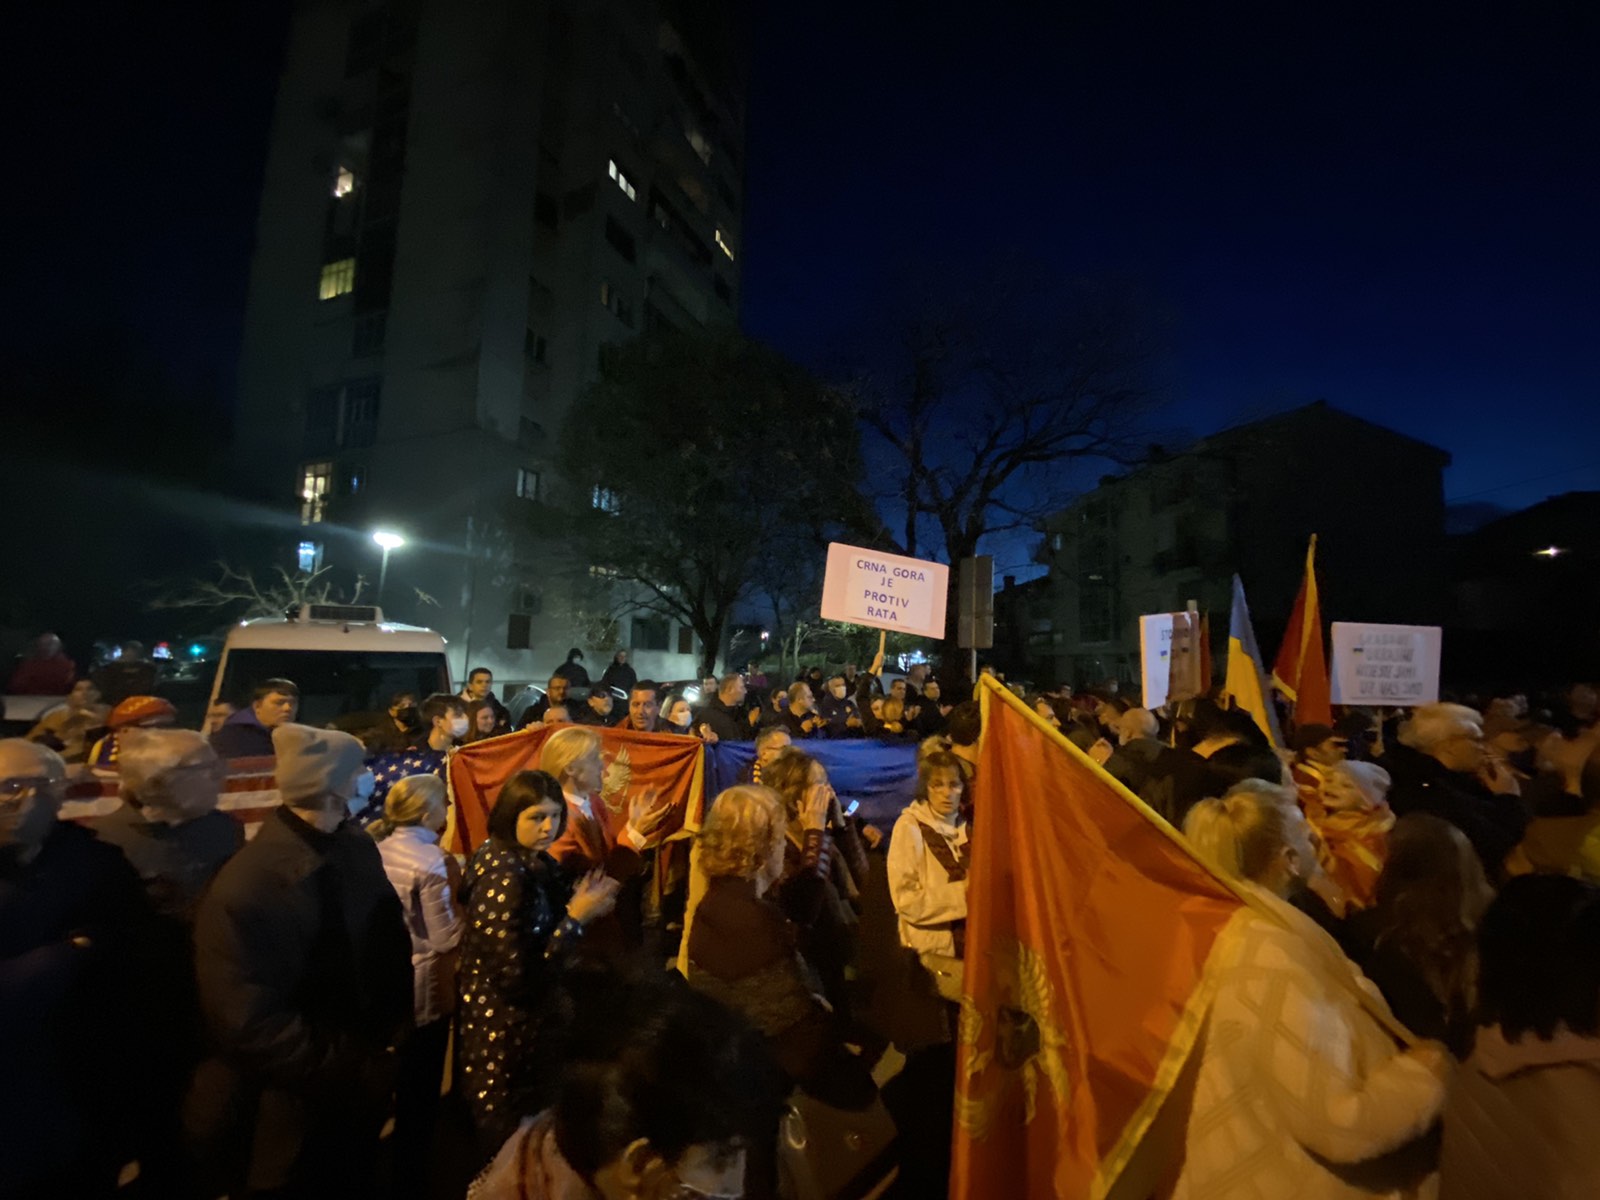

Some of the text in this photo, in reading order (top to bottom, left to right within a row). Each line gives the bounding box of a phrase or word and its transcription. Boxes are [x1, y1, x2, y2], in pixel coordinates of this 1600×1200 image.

[856, 559, 925, 582] CRNA GORA
[880, 577, 894, 588] JE
[864, 589, 910, 608] PROTIV
[867, 606, 898, 621] RATA
